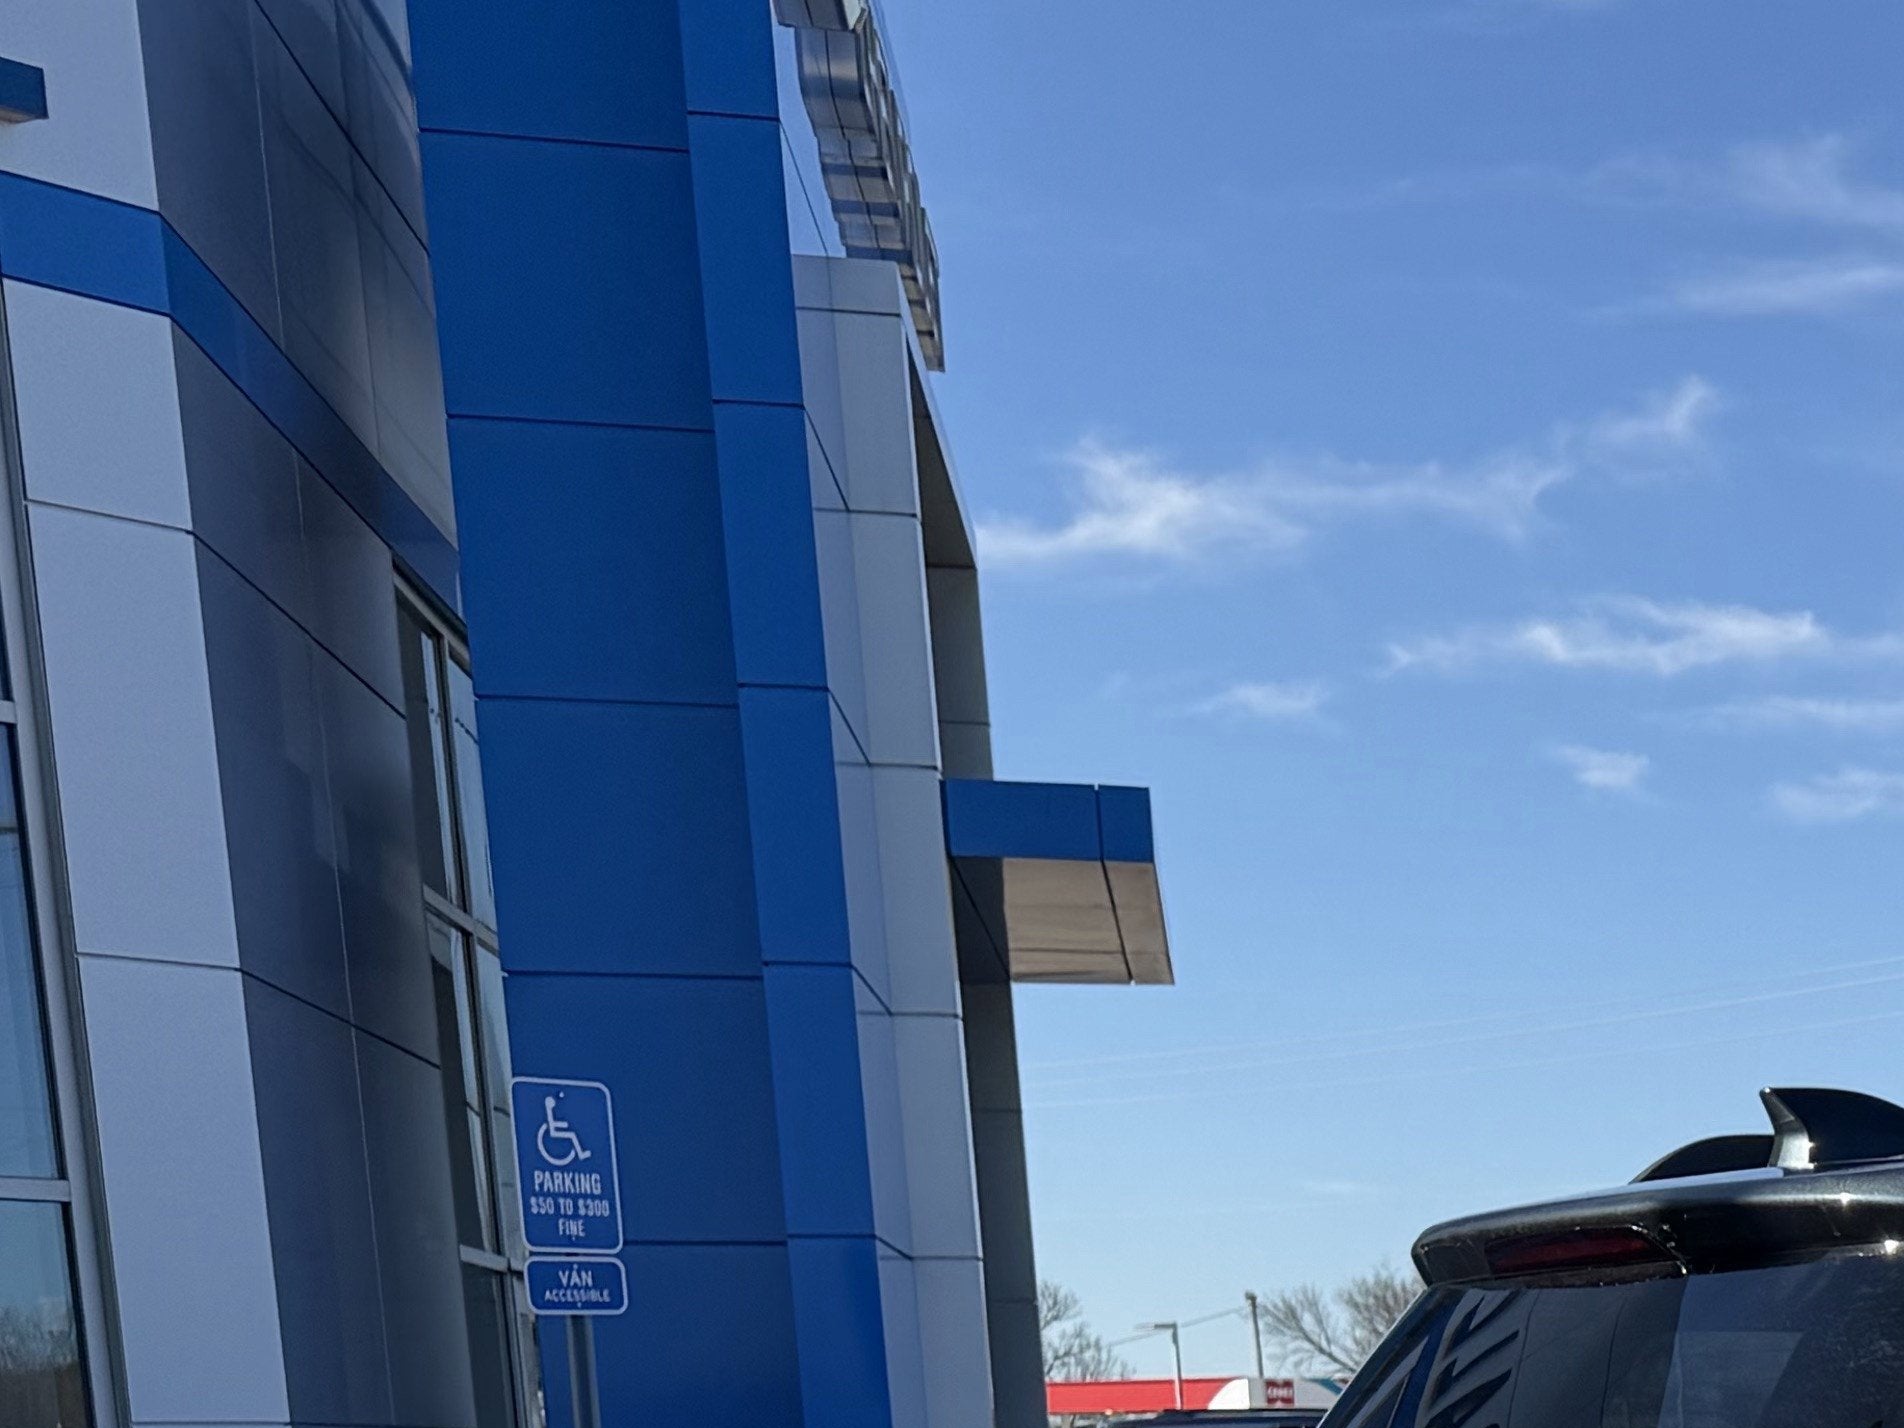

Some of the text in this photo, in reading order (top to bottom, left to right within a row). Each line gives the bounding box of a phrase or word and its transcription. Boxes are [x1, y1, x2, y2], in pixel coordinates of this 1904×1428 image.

[534, 1170, 602, 1195] PARKING
[530, 1196, 610, 1217] $50 TO $300
[558, 1218, 585, 1237] FINE
[558, 1269, 593, 1287] VAN
[545, 1289, 610, 1302] ACCESSIBLE
